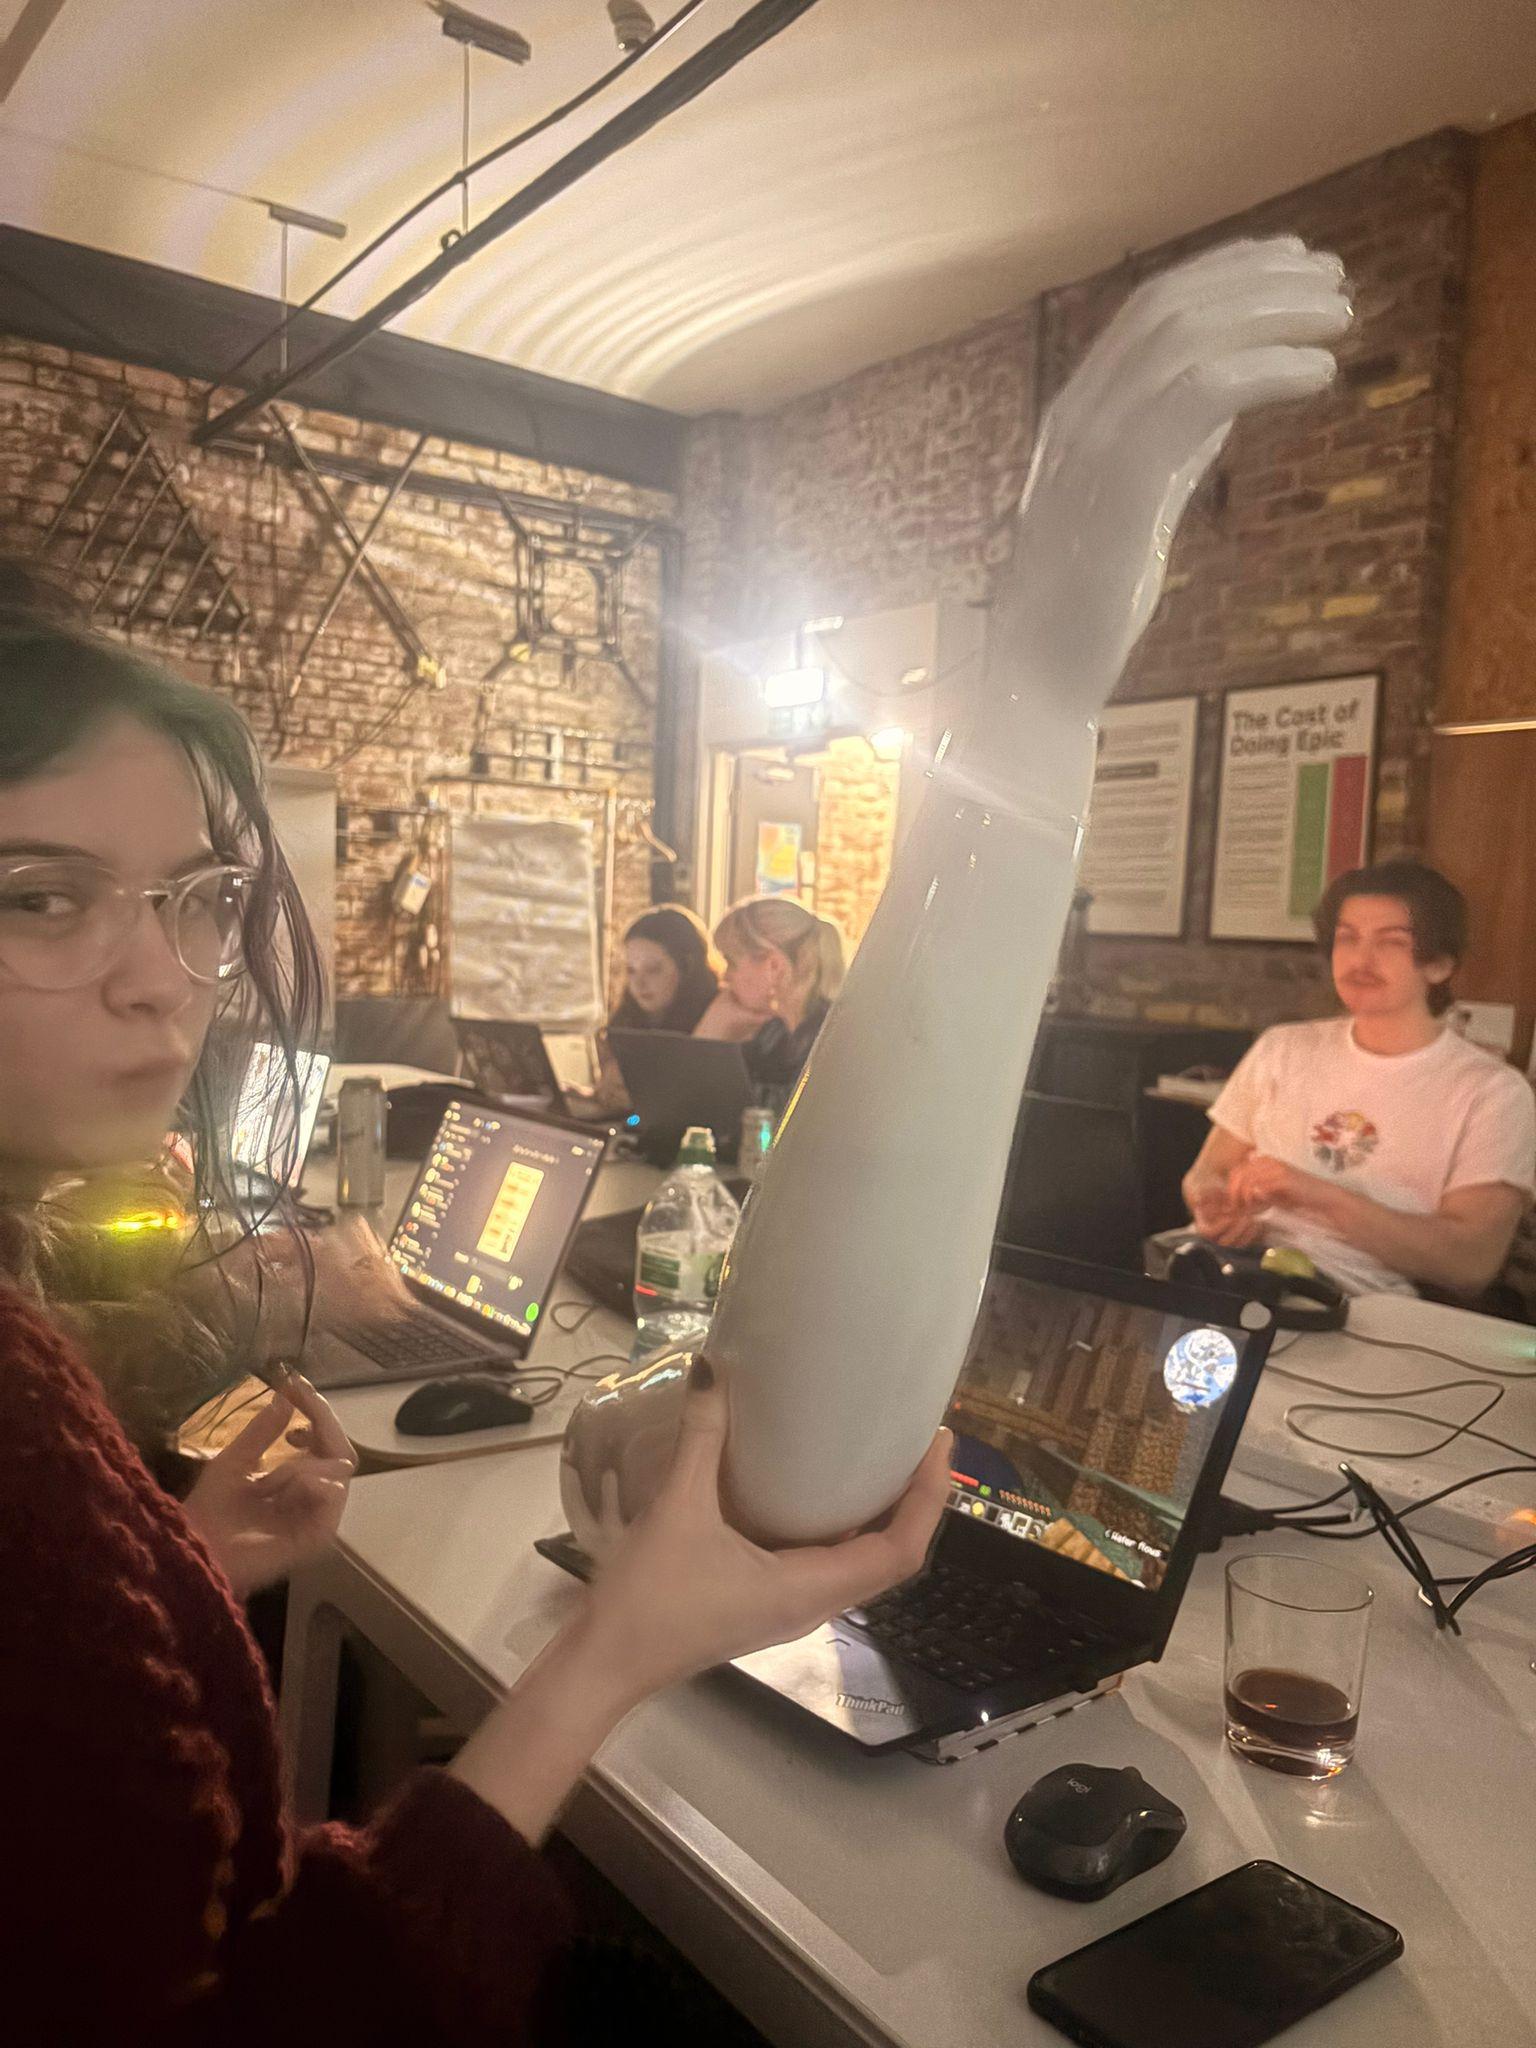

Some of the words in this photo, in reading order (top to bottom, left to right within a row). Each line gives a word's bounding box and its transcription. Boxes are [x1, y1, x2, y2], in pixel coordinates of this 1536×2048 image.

[1233, 709, 1269, 731] The
[1275, 705, 1327, 729] Cost
[1333, 699, 1360, 723] of
[1230, 735, 1290, 758] Doing
[1297, 729, 1343, 753] Epic
[836, 1693, 905, 1716] ThinkPad
